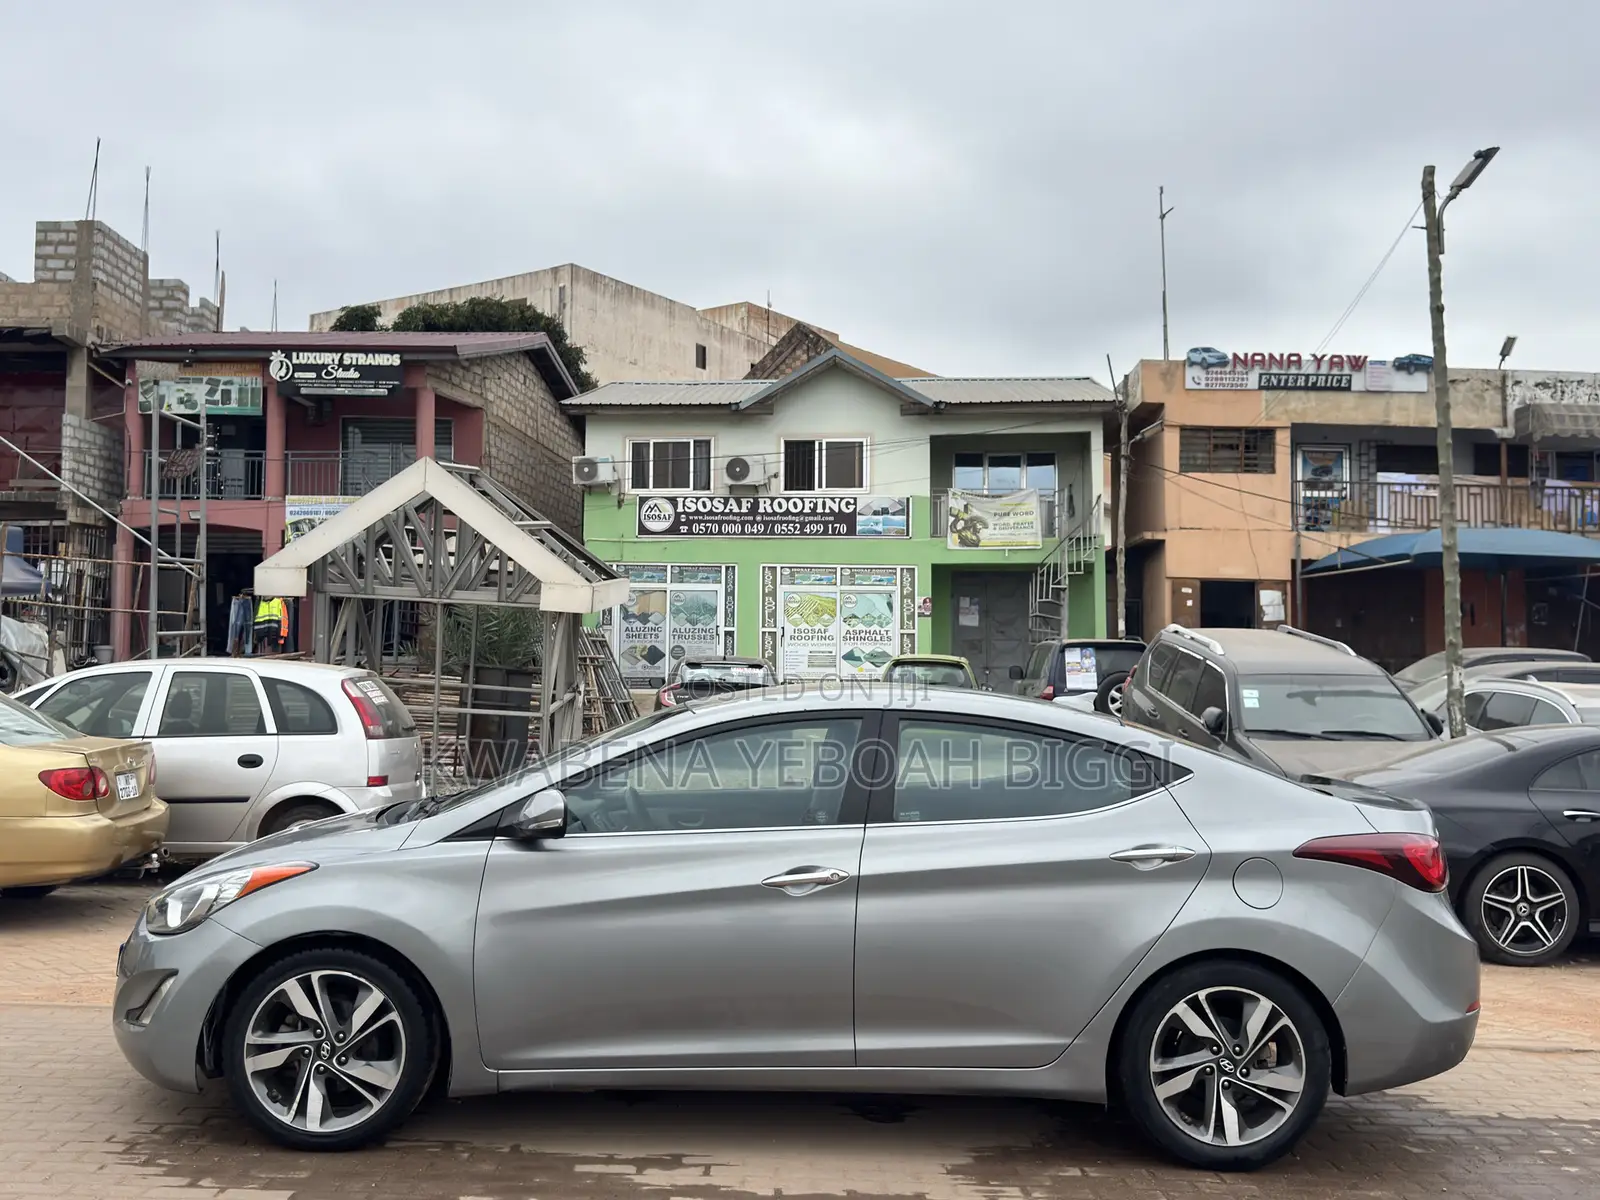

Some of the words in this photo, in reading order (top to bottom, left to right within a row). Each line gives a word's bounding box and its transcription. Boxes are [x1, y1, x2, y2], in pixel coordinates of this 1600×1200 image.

[292, 352, 342, 365] LUXURY
[343, 353, 401, 366] STRANDS
[1232, 352, 1303, 371] NANA
[1310, 354, 1368, 372] YAW
[321, 364, 360, 379] Studio
[676, 497, 754, 513] ISOSAF
[757, 498, 856, 513] ROOFING
[643, 513, 673, 521] ISOSAF
[688, 514, 754, 522] www.isosafroofing.com
[692, 523, 719, 534] 0570
[721, 523, 741, 534] 000
[744, 523, 765, 534] 049
[767, 523, 772, 534] /
[774, 523, 801, 534] 0552
[803, 523, 824, 534] 499
[828, 523, 847, 534] 170
